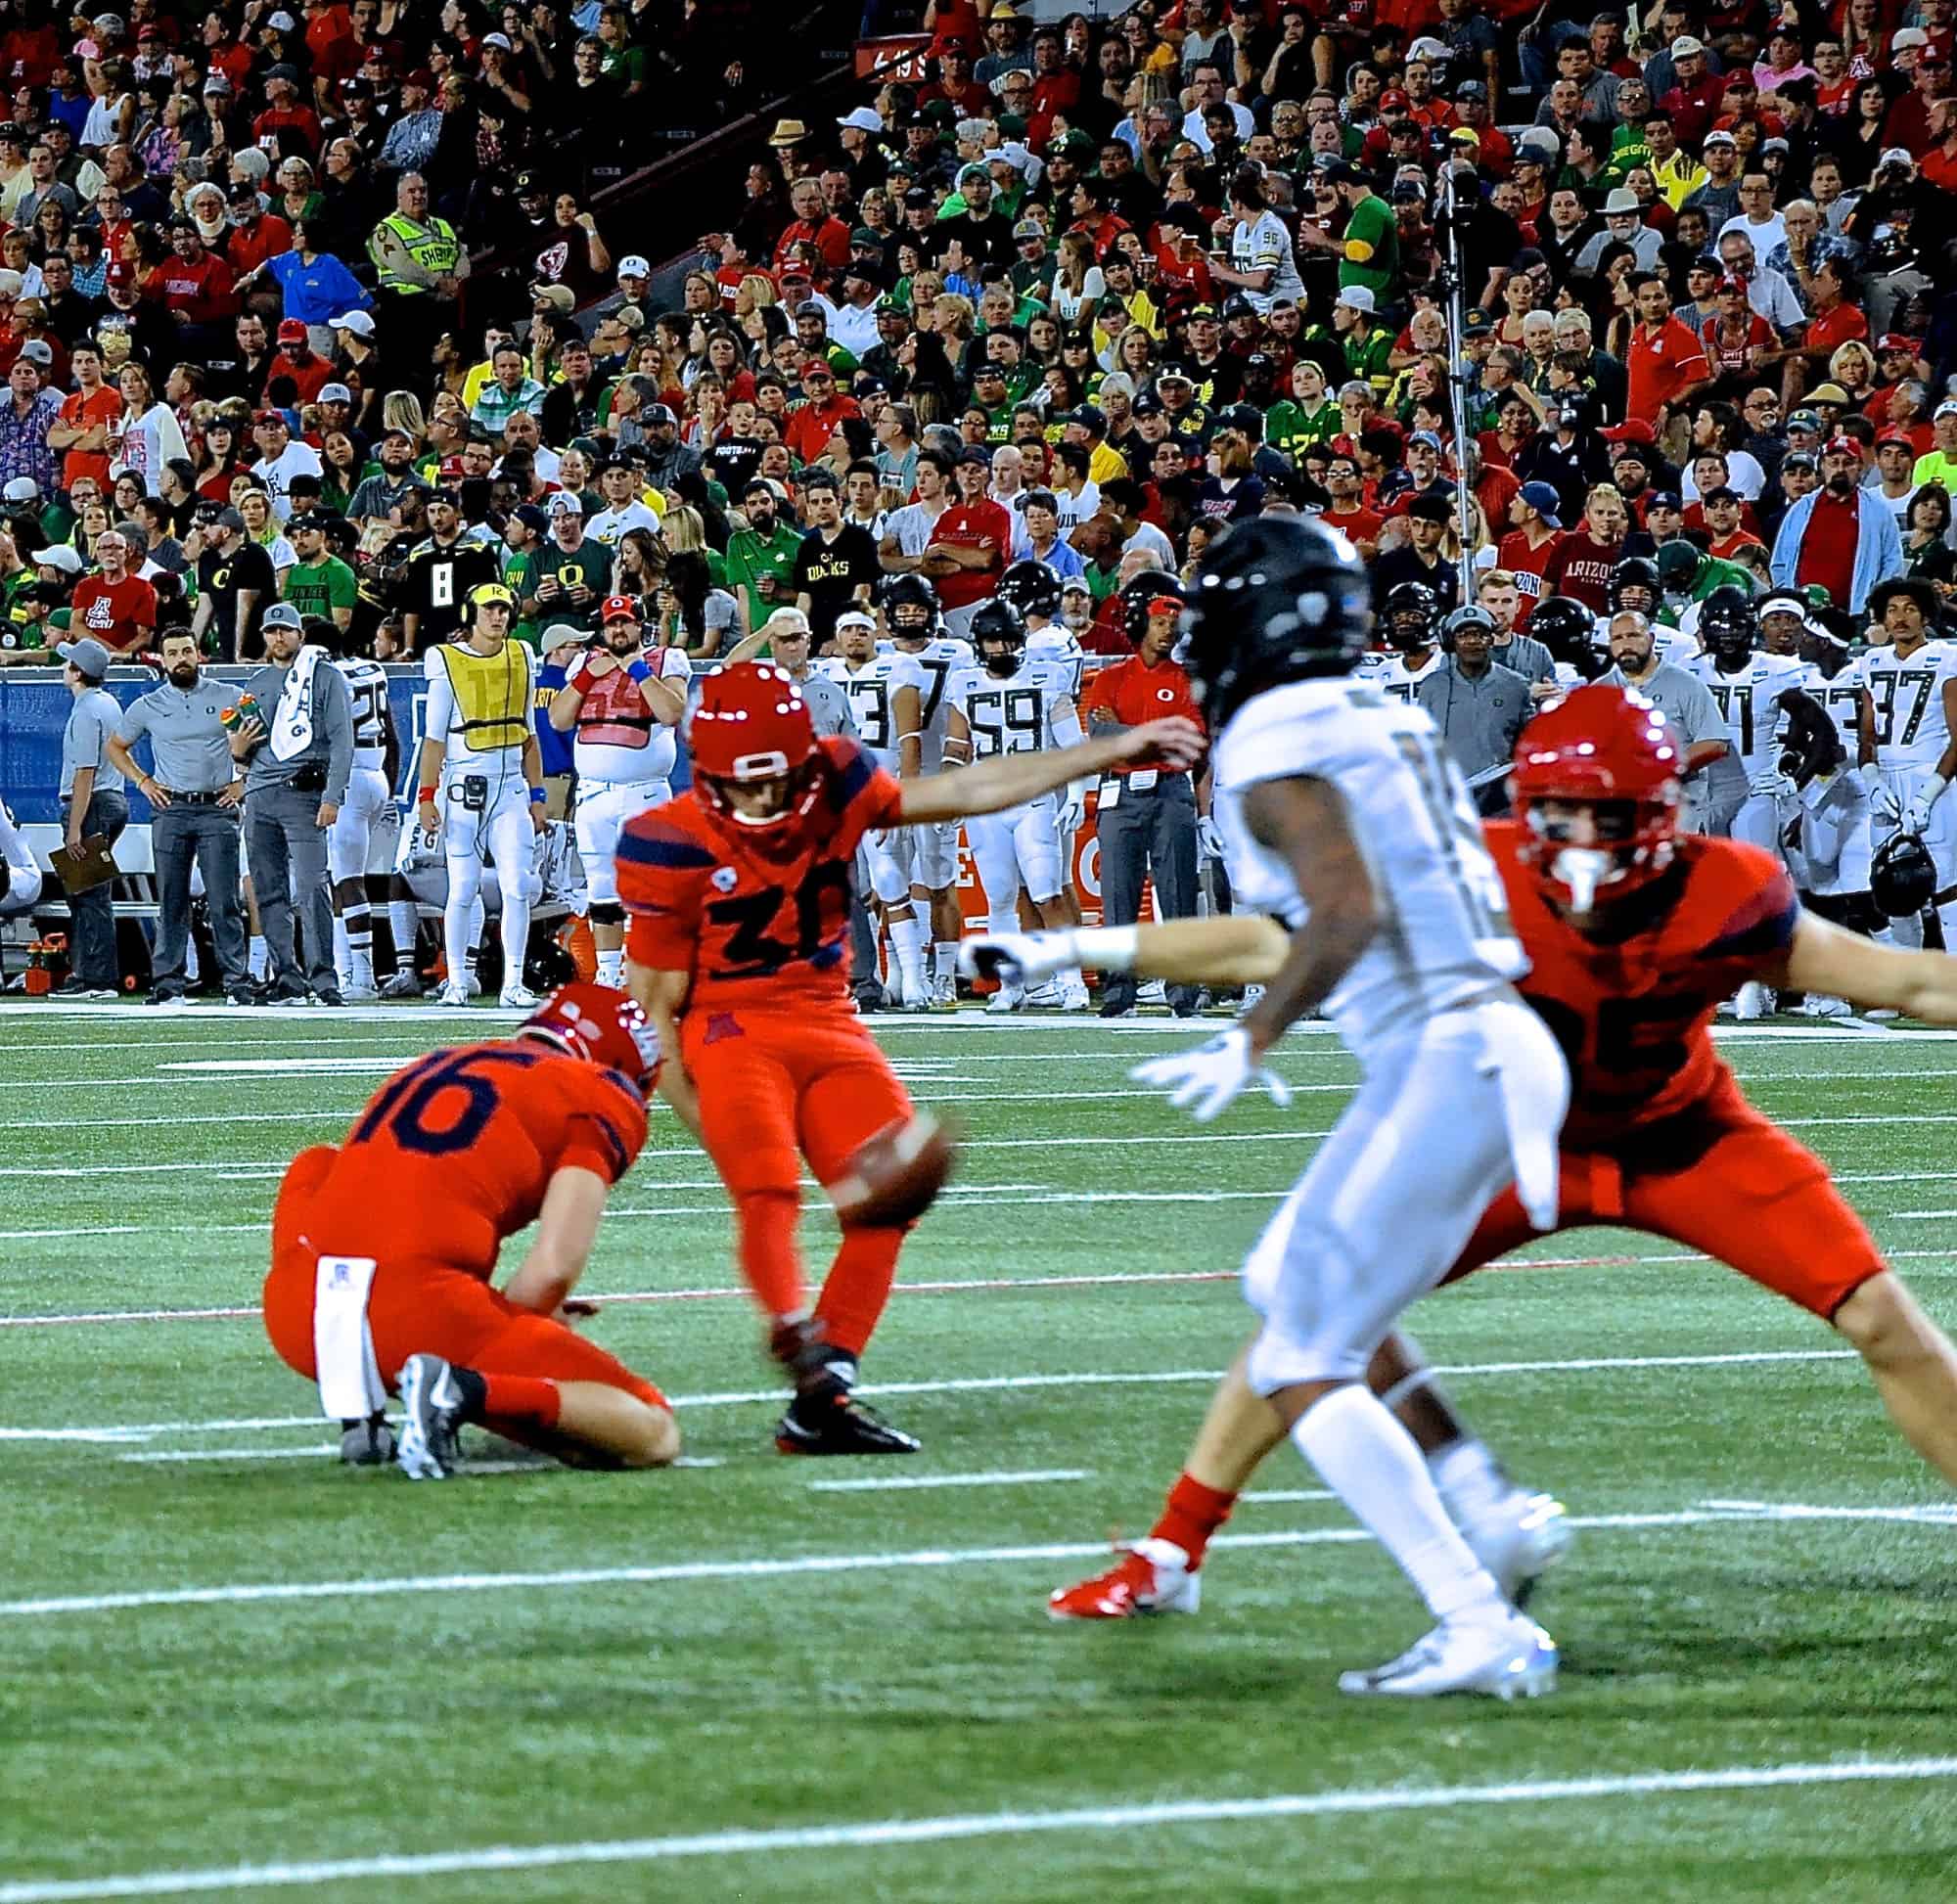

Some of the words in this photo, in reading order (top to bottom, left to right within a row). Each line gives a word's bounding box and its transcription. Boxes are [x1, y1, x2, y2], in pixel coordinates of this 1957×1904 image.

[1849, 53, 1876, 78] A
[432, 562, 454, 609] 8
[558, 565, 584, 586] O
[88, 596, 112, 618] A
[1869, 670, 1937, 747] 37
[353, 1049, 540, 1156] 16
